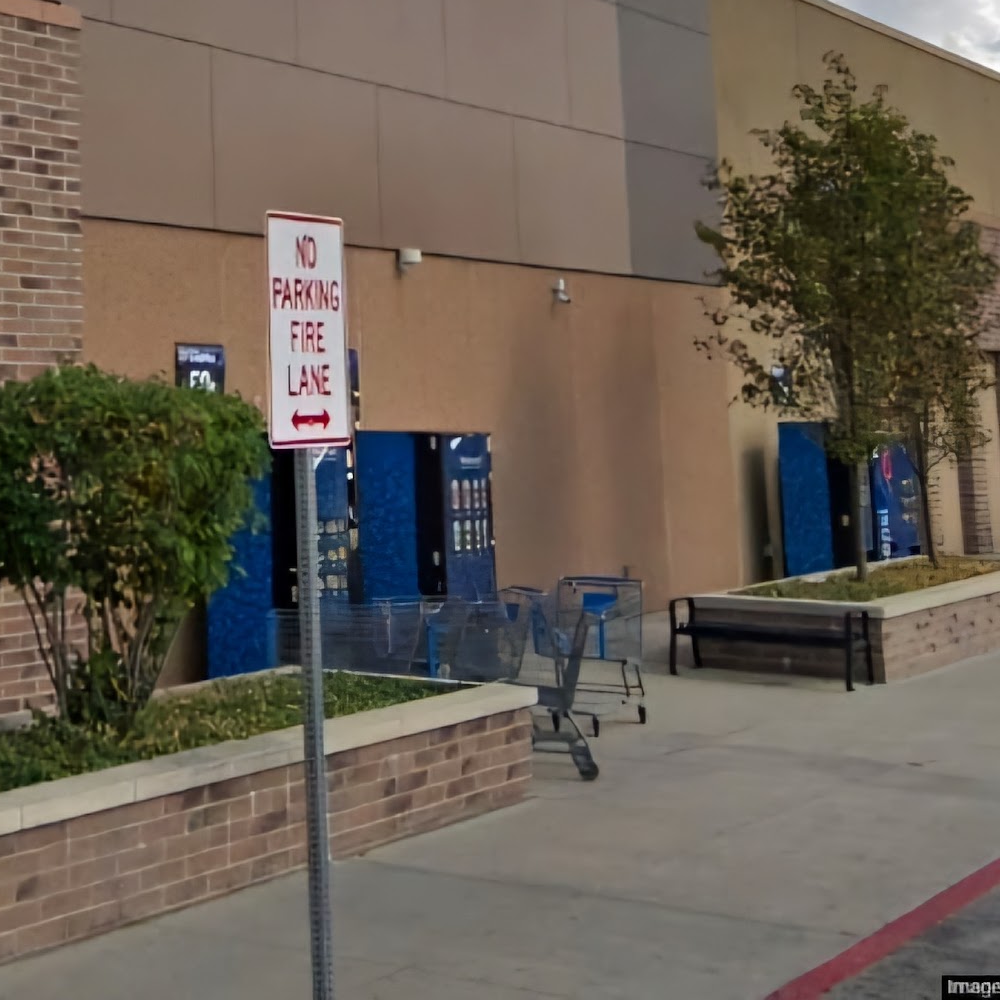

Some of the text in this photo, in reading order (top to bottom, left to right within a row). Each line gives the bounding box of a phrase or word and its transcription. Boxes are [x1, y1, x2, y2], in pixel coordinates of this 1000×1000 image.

[295, 234, 317, 269] NO
[272, 277, 340, 311] PARKING
[290, 321, 326, 353] FIRE
[288, 364, 331, 396] LANE
